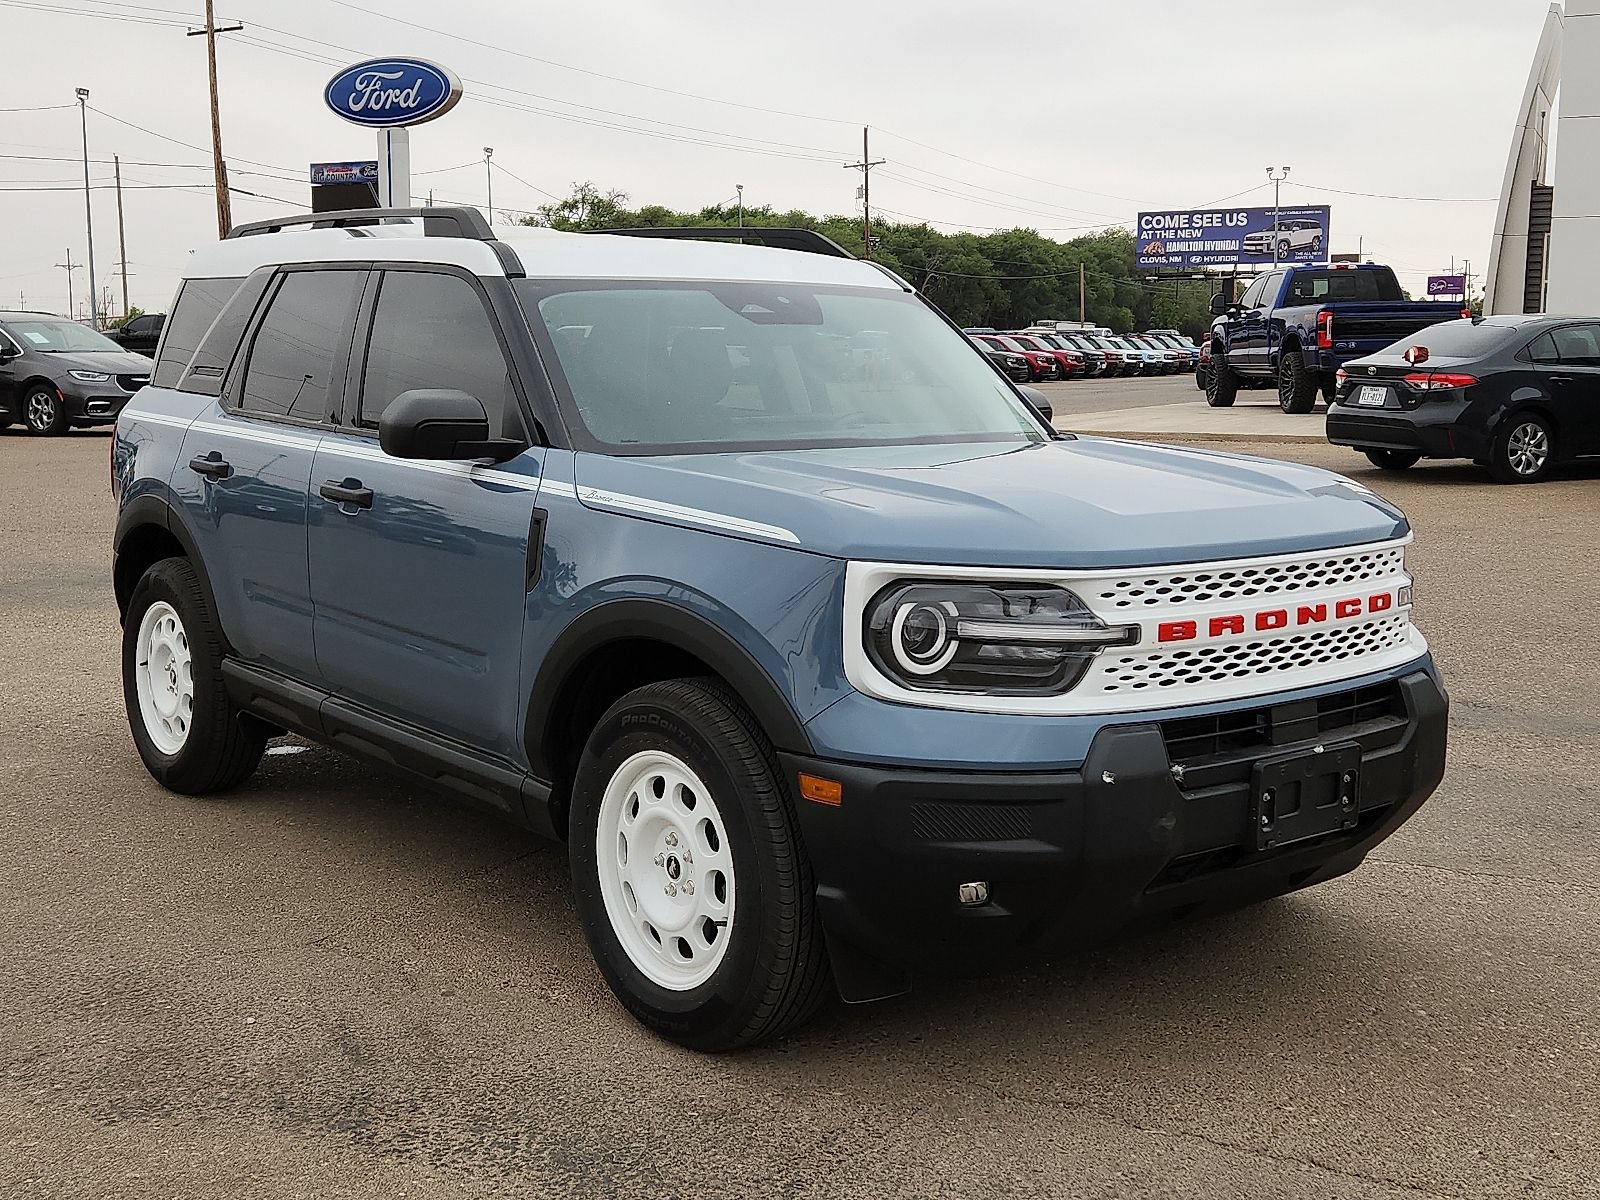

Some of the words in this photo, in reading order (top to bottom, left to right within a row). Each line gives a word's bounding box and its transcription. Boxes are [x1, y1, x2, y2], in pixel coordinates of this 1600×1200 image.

[349, 71, 423, 112] Ford
[326, 173, 357, 182] COUNTRY
[1141, 214, 1190, 230] COME
[1192, 213, 1223, 228] SEE
[1225, 212, 1248, 227] US
[1140, 230, 1154, 240] AT
[1155, 229, 1176, 239] THE
[1177, 229, 1203, 239] NEW
[1166, 240, 1204, 253] HAMILTON
[1204, 239, 1240, 252] HYUNDAI
[1139, 256, 1169, 264] CLOVIS,
[1169, 255, 1182, 263] NM
[1157, 592, 1392, 643] BRONCO
